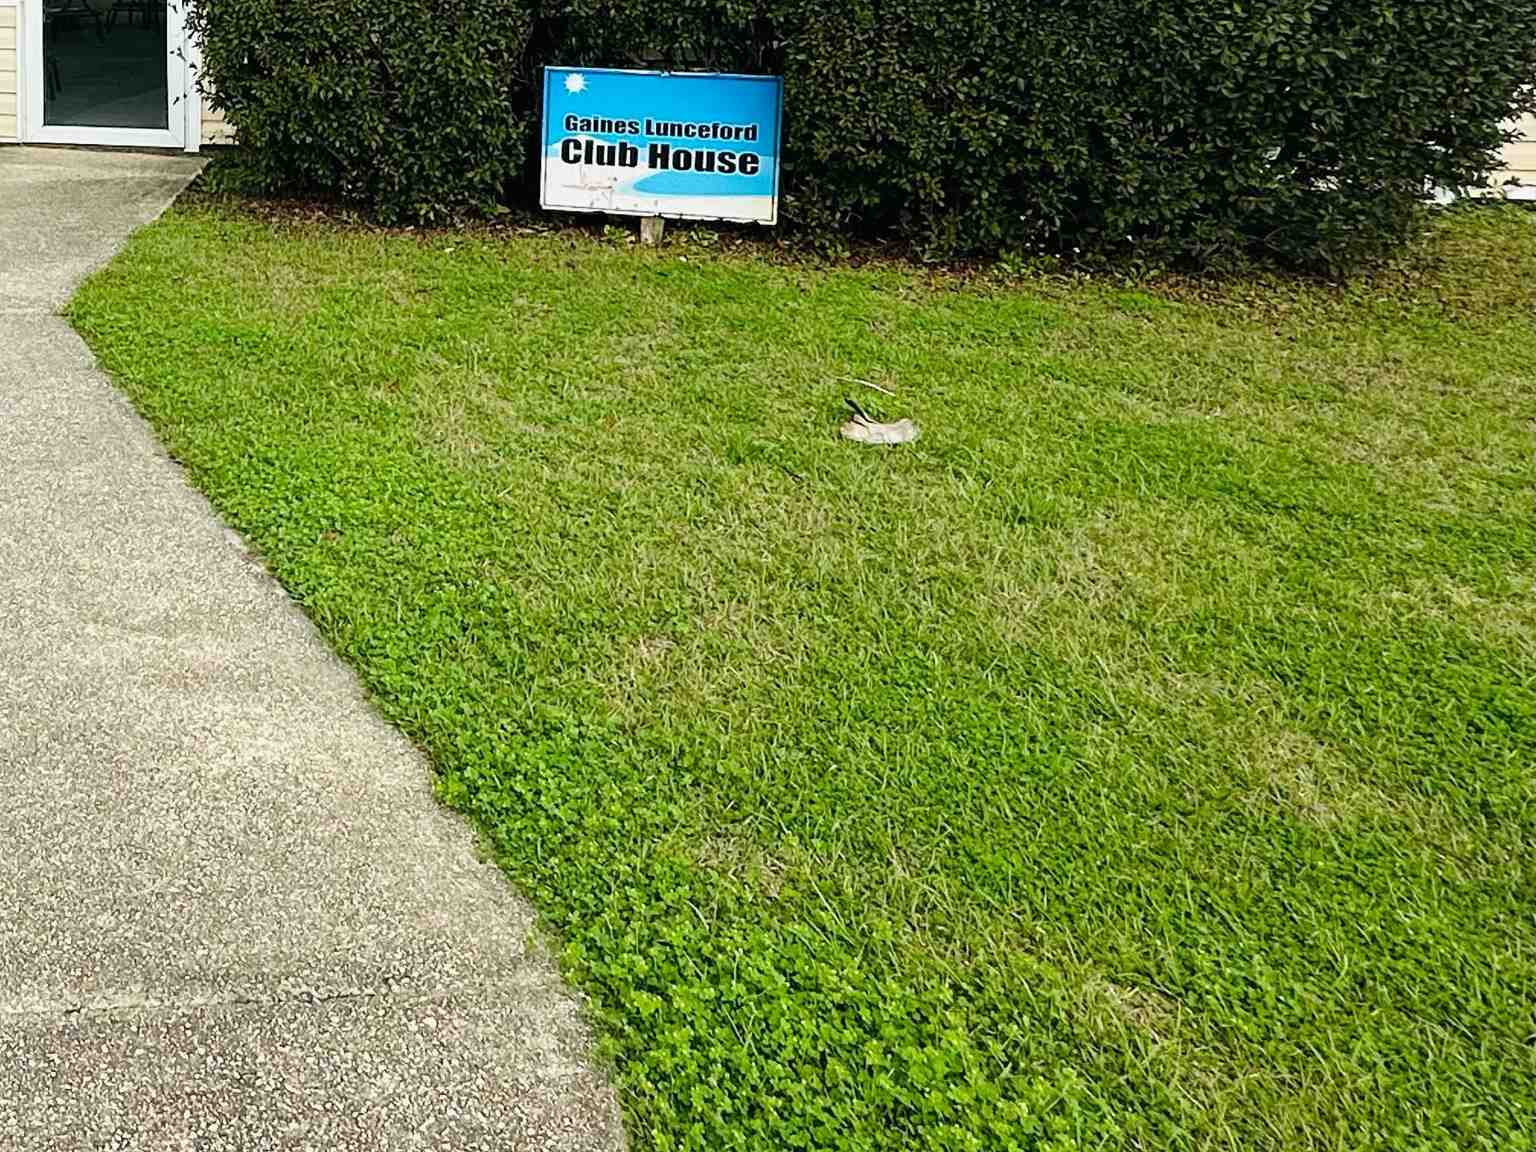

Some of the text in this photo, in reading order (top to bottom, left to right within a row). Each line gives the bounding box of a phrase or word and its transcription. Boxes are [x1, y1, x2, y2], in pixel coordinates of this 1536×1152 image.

[565, 114, 758, 141] Gaines Lunceford
[560, 138, 760, 175] Club House
